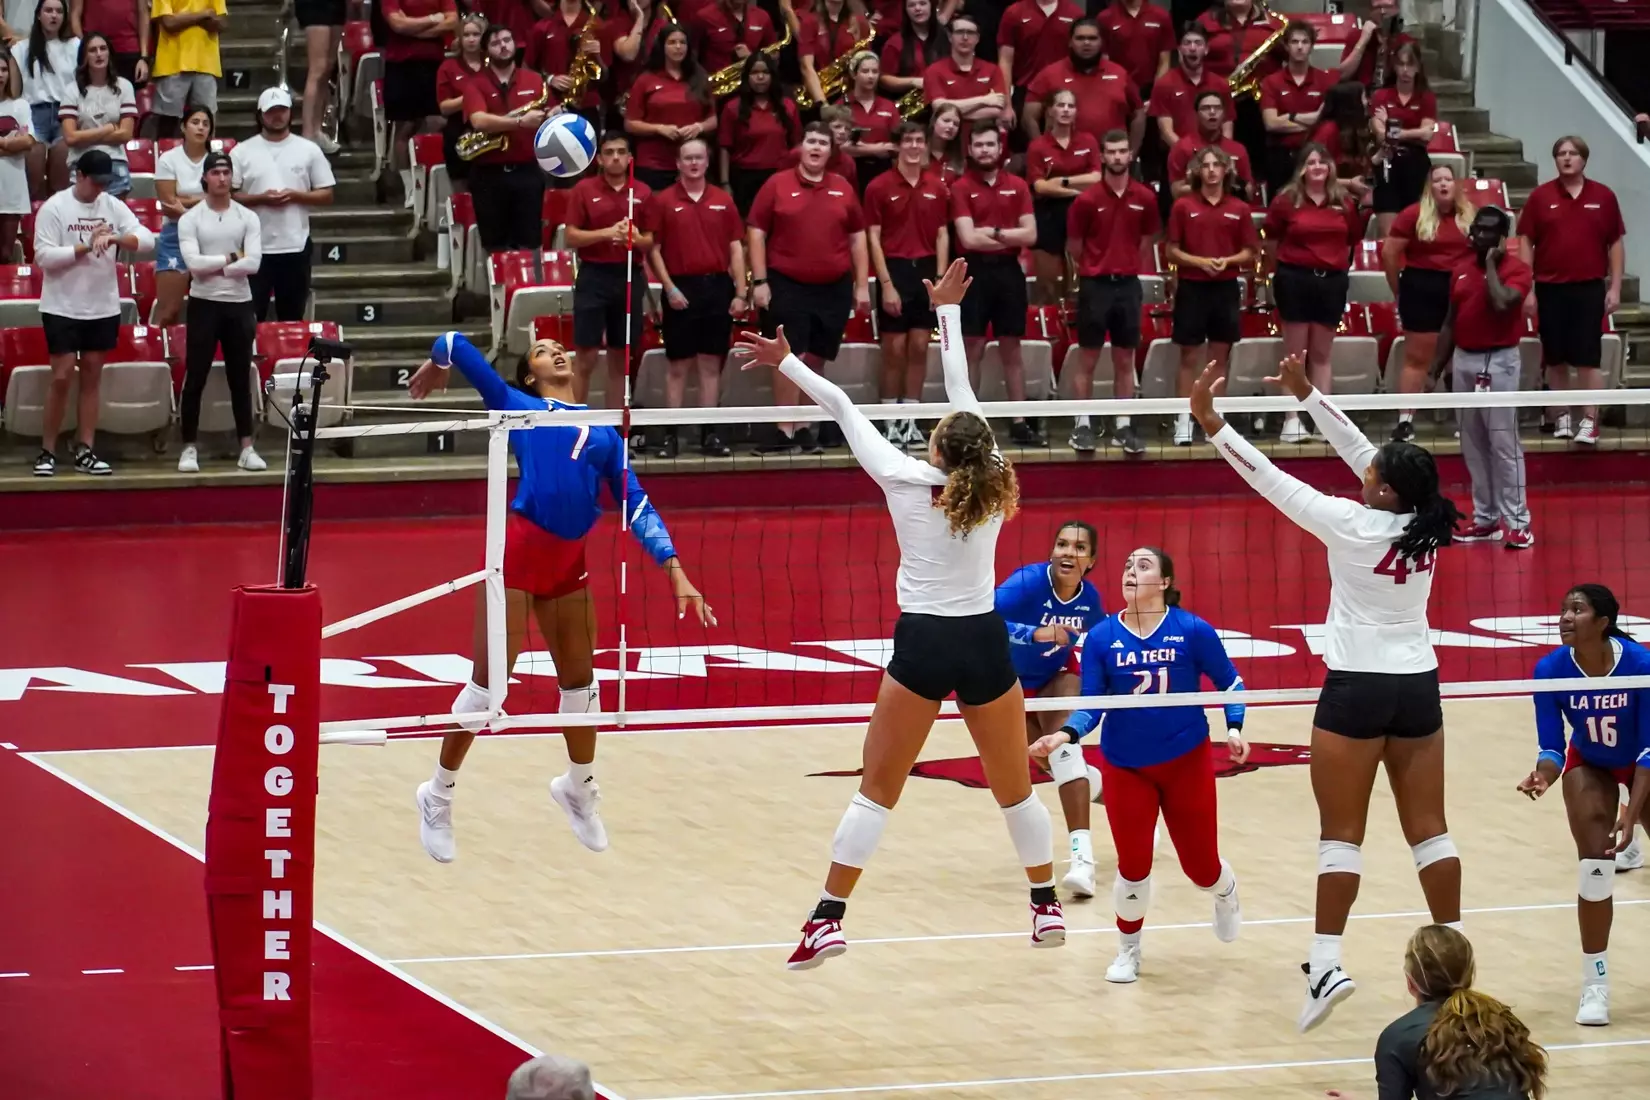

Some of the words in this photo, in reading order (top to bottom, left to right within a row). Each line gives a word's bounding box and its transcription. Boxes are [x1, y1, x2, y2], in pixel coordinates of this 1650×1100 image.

[232, 72, 243, 86] 7
[328, 246, 340, 260] 4
[363, 305, 375, 321] 3
[398, 369, 410, 387] 2
[437, 435, 444, 450] 1
[1116, 651, 1137, 667] LA
[1141, 647, 1176, 663] TECH
[1132, 666, 1168, 696] 21
[1570, 695, 1589, 710] LA
[1593, 692, 1628, 710] TECH
[1586, 715, 1618, 748] 16
[263, 683, 296, 1001] TOGETHER
